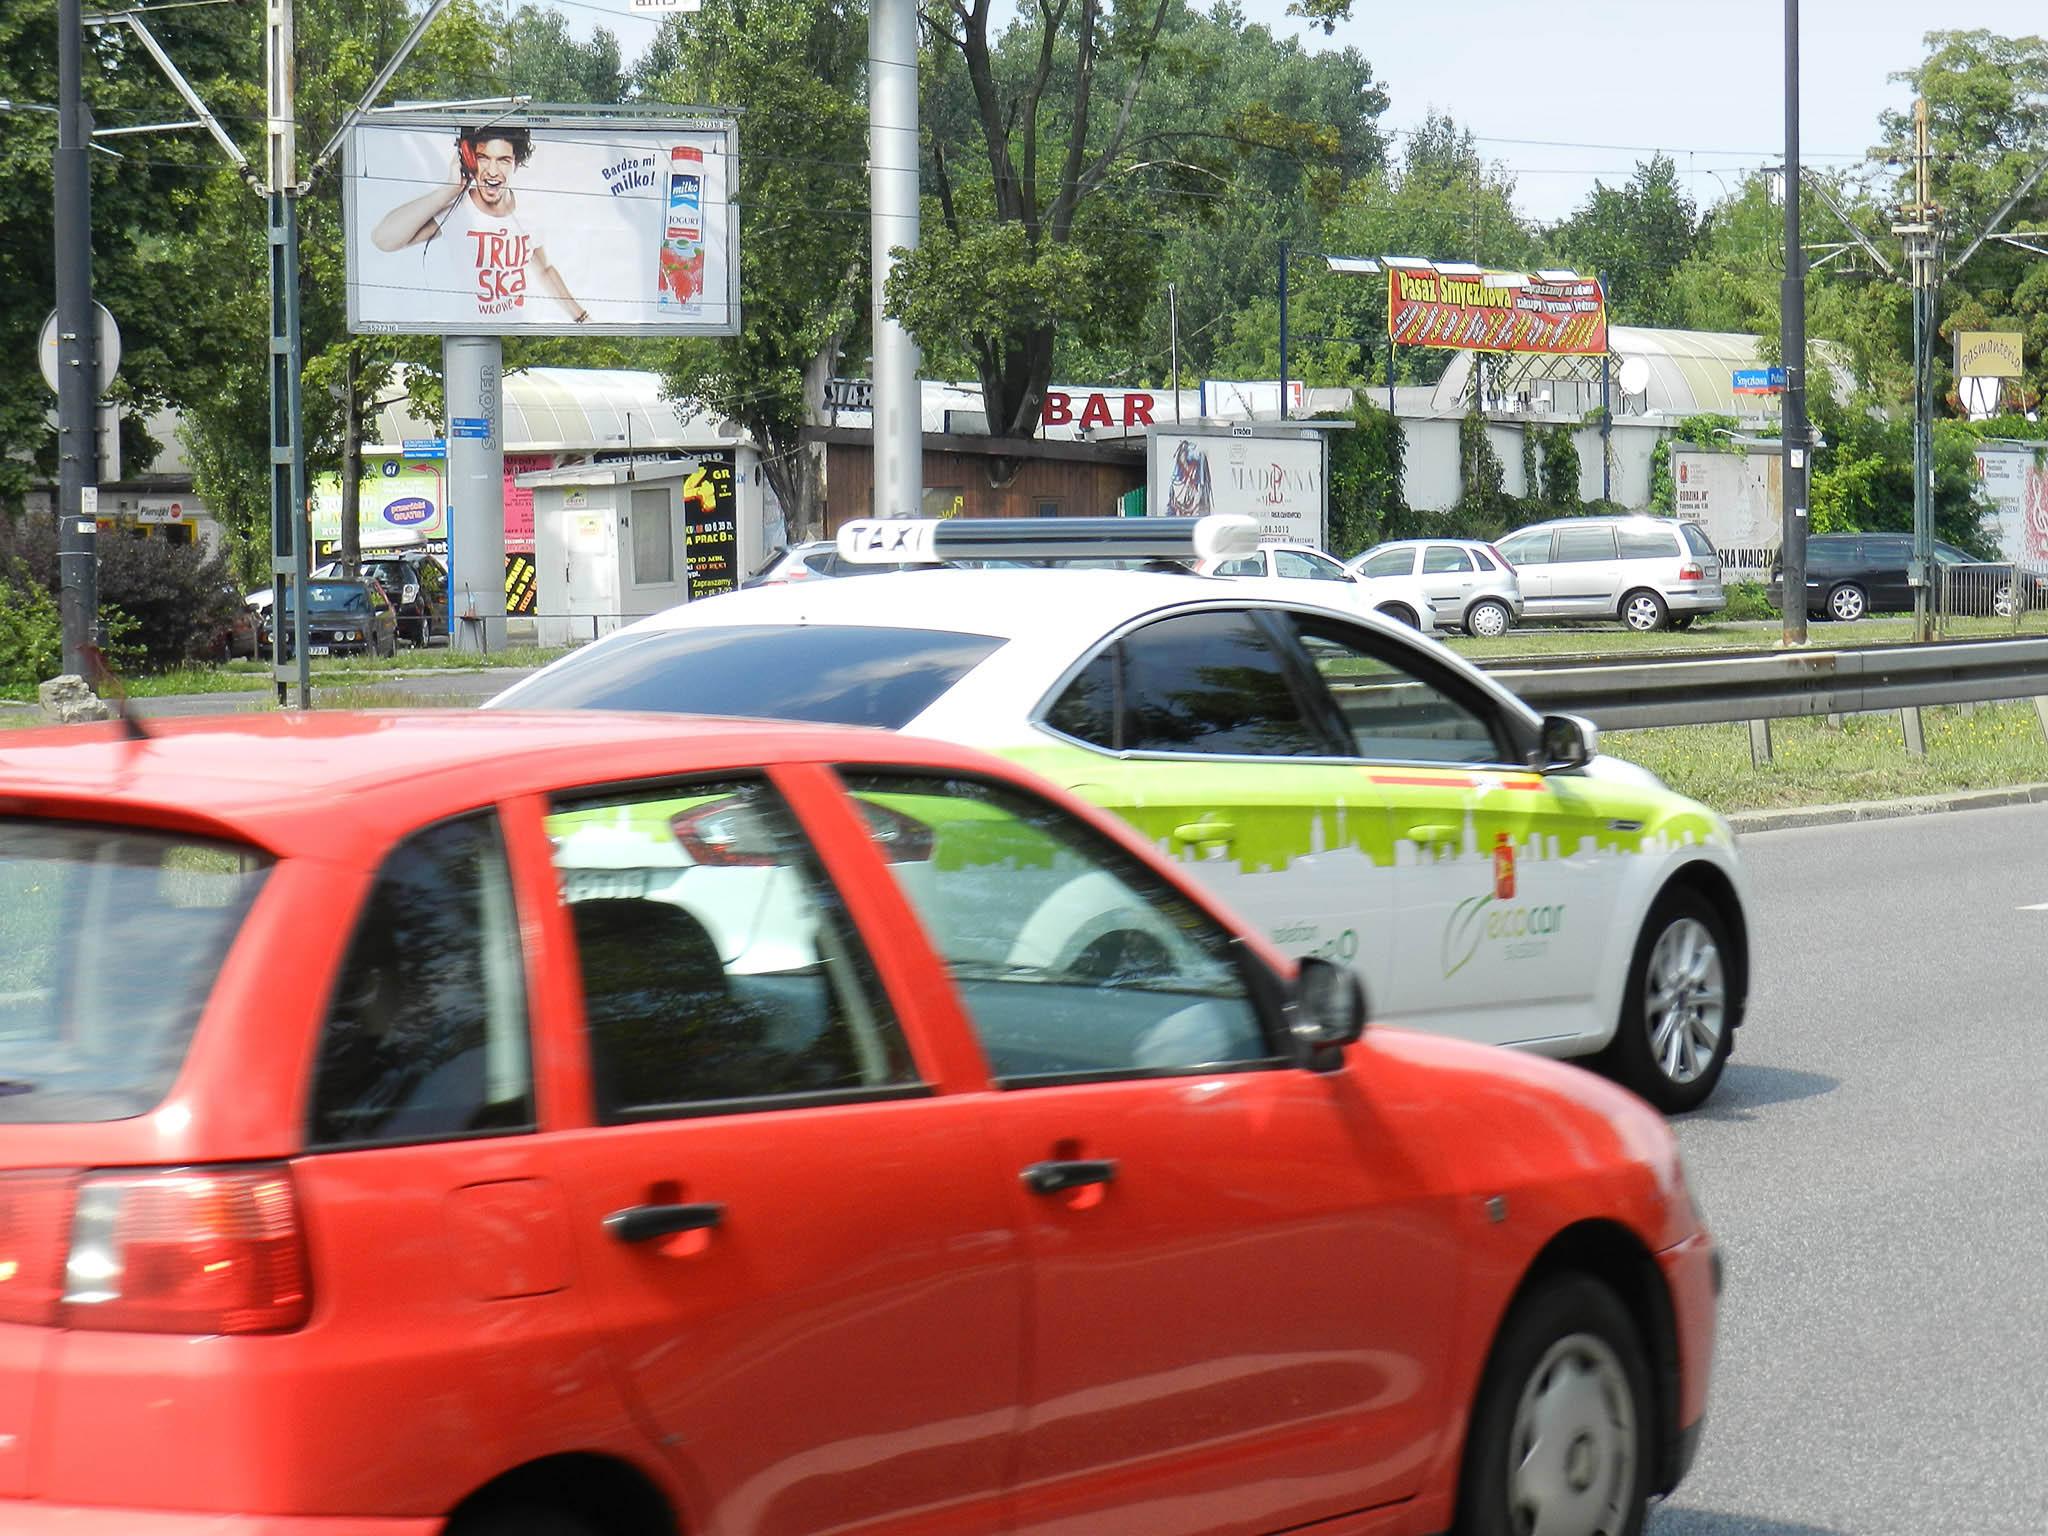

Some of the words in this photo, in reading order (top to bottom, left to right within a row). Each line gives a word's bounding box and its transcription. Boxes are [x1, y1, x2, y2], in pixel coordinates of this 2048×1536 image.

[602, 157, 638, 180] Bardzo
[643, 154, 656, 167] mi
[611, 171, 656, 197] milko!
[671, 181, 700, 196] milko
[467, 228, 530, 270] TRUE
[1399, 271, 1437, 303] Pasaż
[1961, 338, 2021, 372] Pasmanteria
[1042, 392, 1156, 427] BAR
[385, 465, 396, 476] 61
[712, 468, 731, 480] GR
[851, 527, 923, 552] TAXI
[521, 564, 535, 585] DVD
[1487, 904, 1565, 939] ecocar
